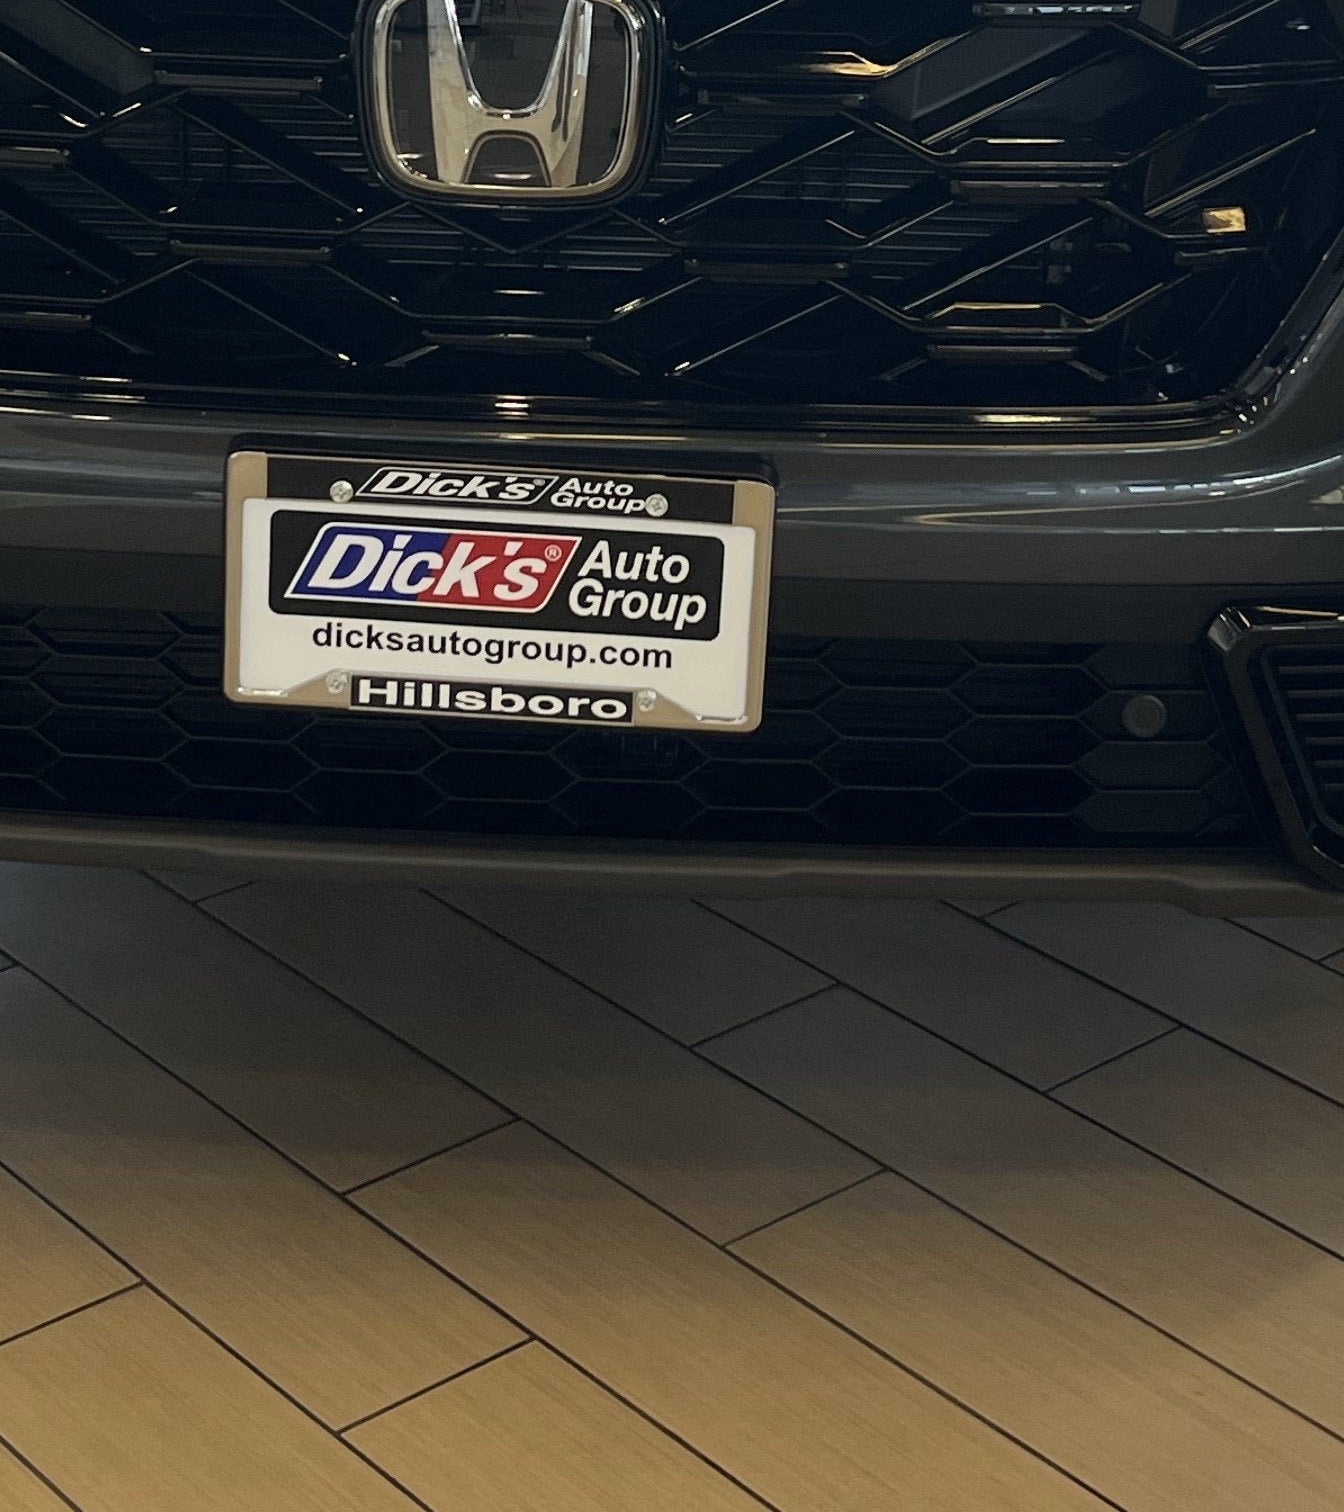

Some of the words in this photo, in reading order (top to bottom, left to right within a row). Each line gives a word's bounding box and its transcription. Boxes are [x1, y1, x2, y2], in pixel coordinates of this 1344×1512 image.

[370, 470, 537, 501] Dick's
[550, 491, 646, 514] Group
[558, 476, 634, 496] Auto
[307, 533, 548, 603] Dick's
[578, 540, 691, 584] Auto
[568, 579, 707, 631] Group
[312, 623, 673, 670] dicksautogroup.com
[357, 679, 628, 720] Hillsboro
